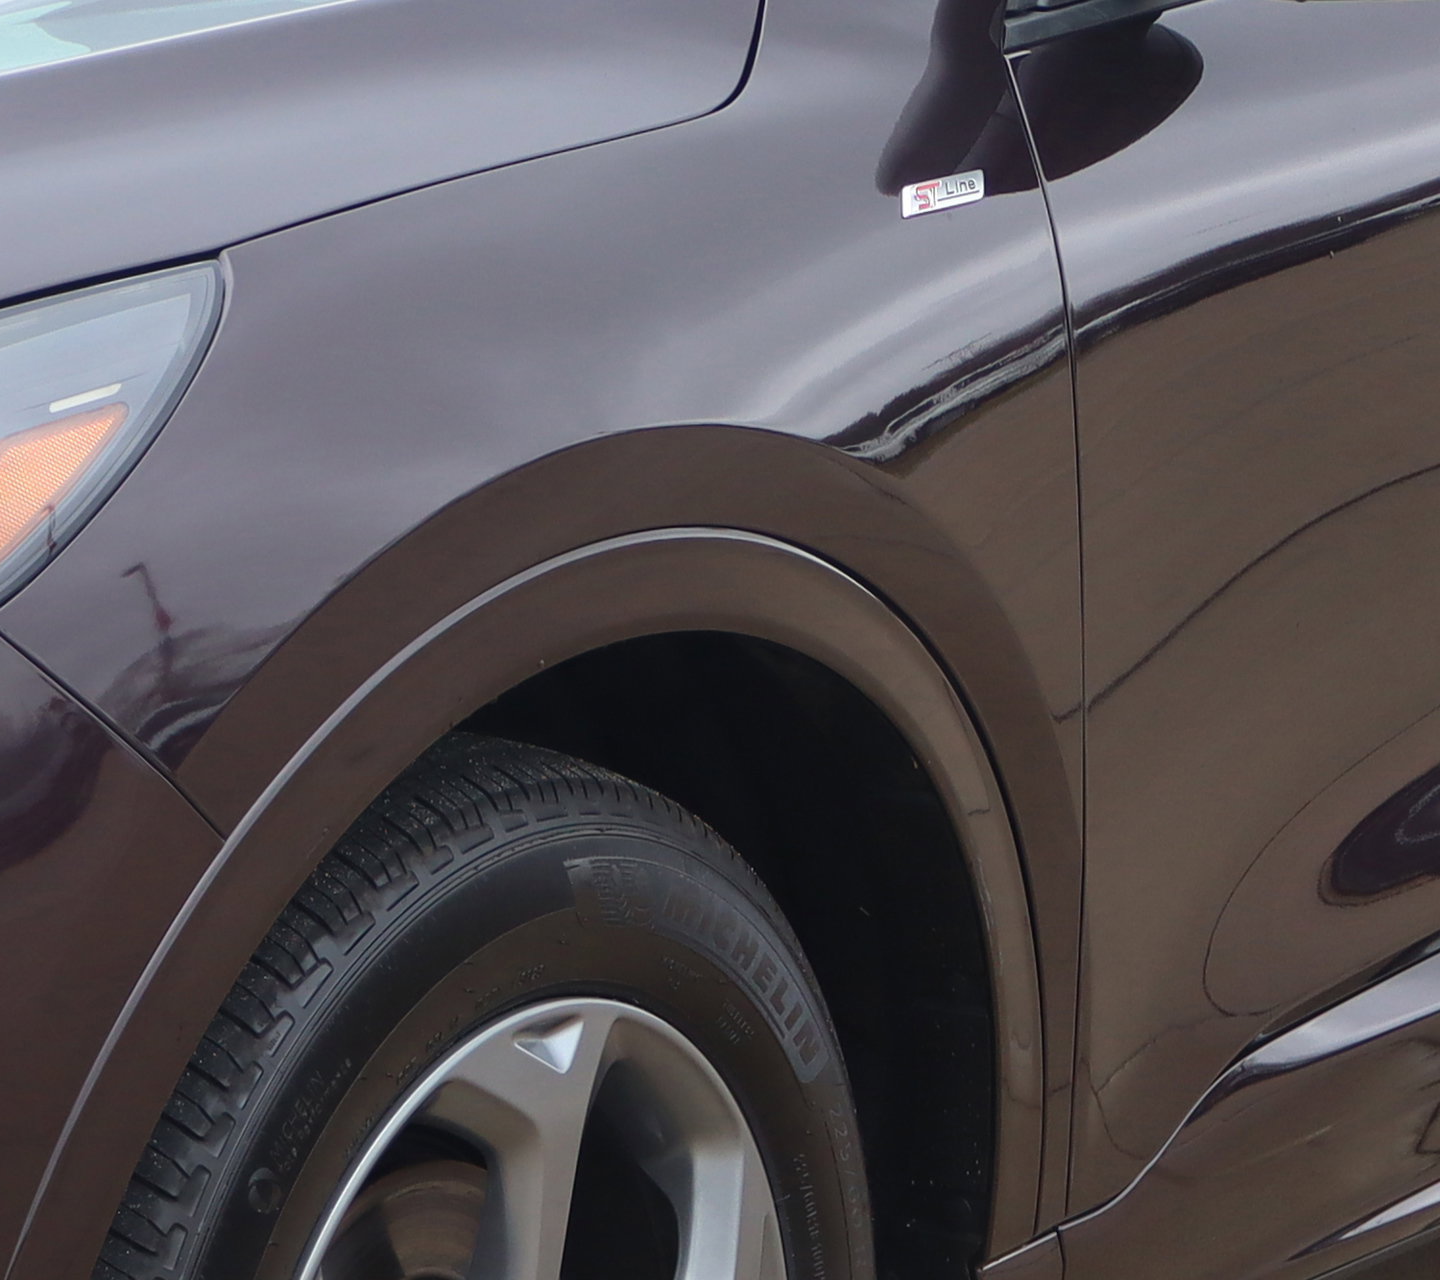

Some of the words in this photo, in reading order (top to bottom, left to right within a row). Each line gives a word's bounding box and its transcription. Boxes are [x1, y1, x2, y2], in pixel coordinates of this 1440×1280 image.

[914, 181, 941, 211] ST
[945, 178, 977, 196] Line
[663, 885, 828, 1070] MICHELIN
